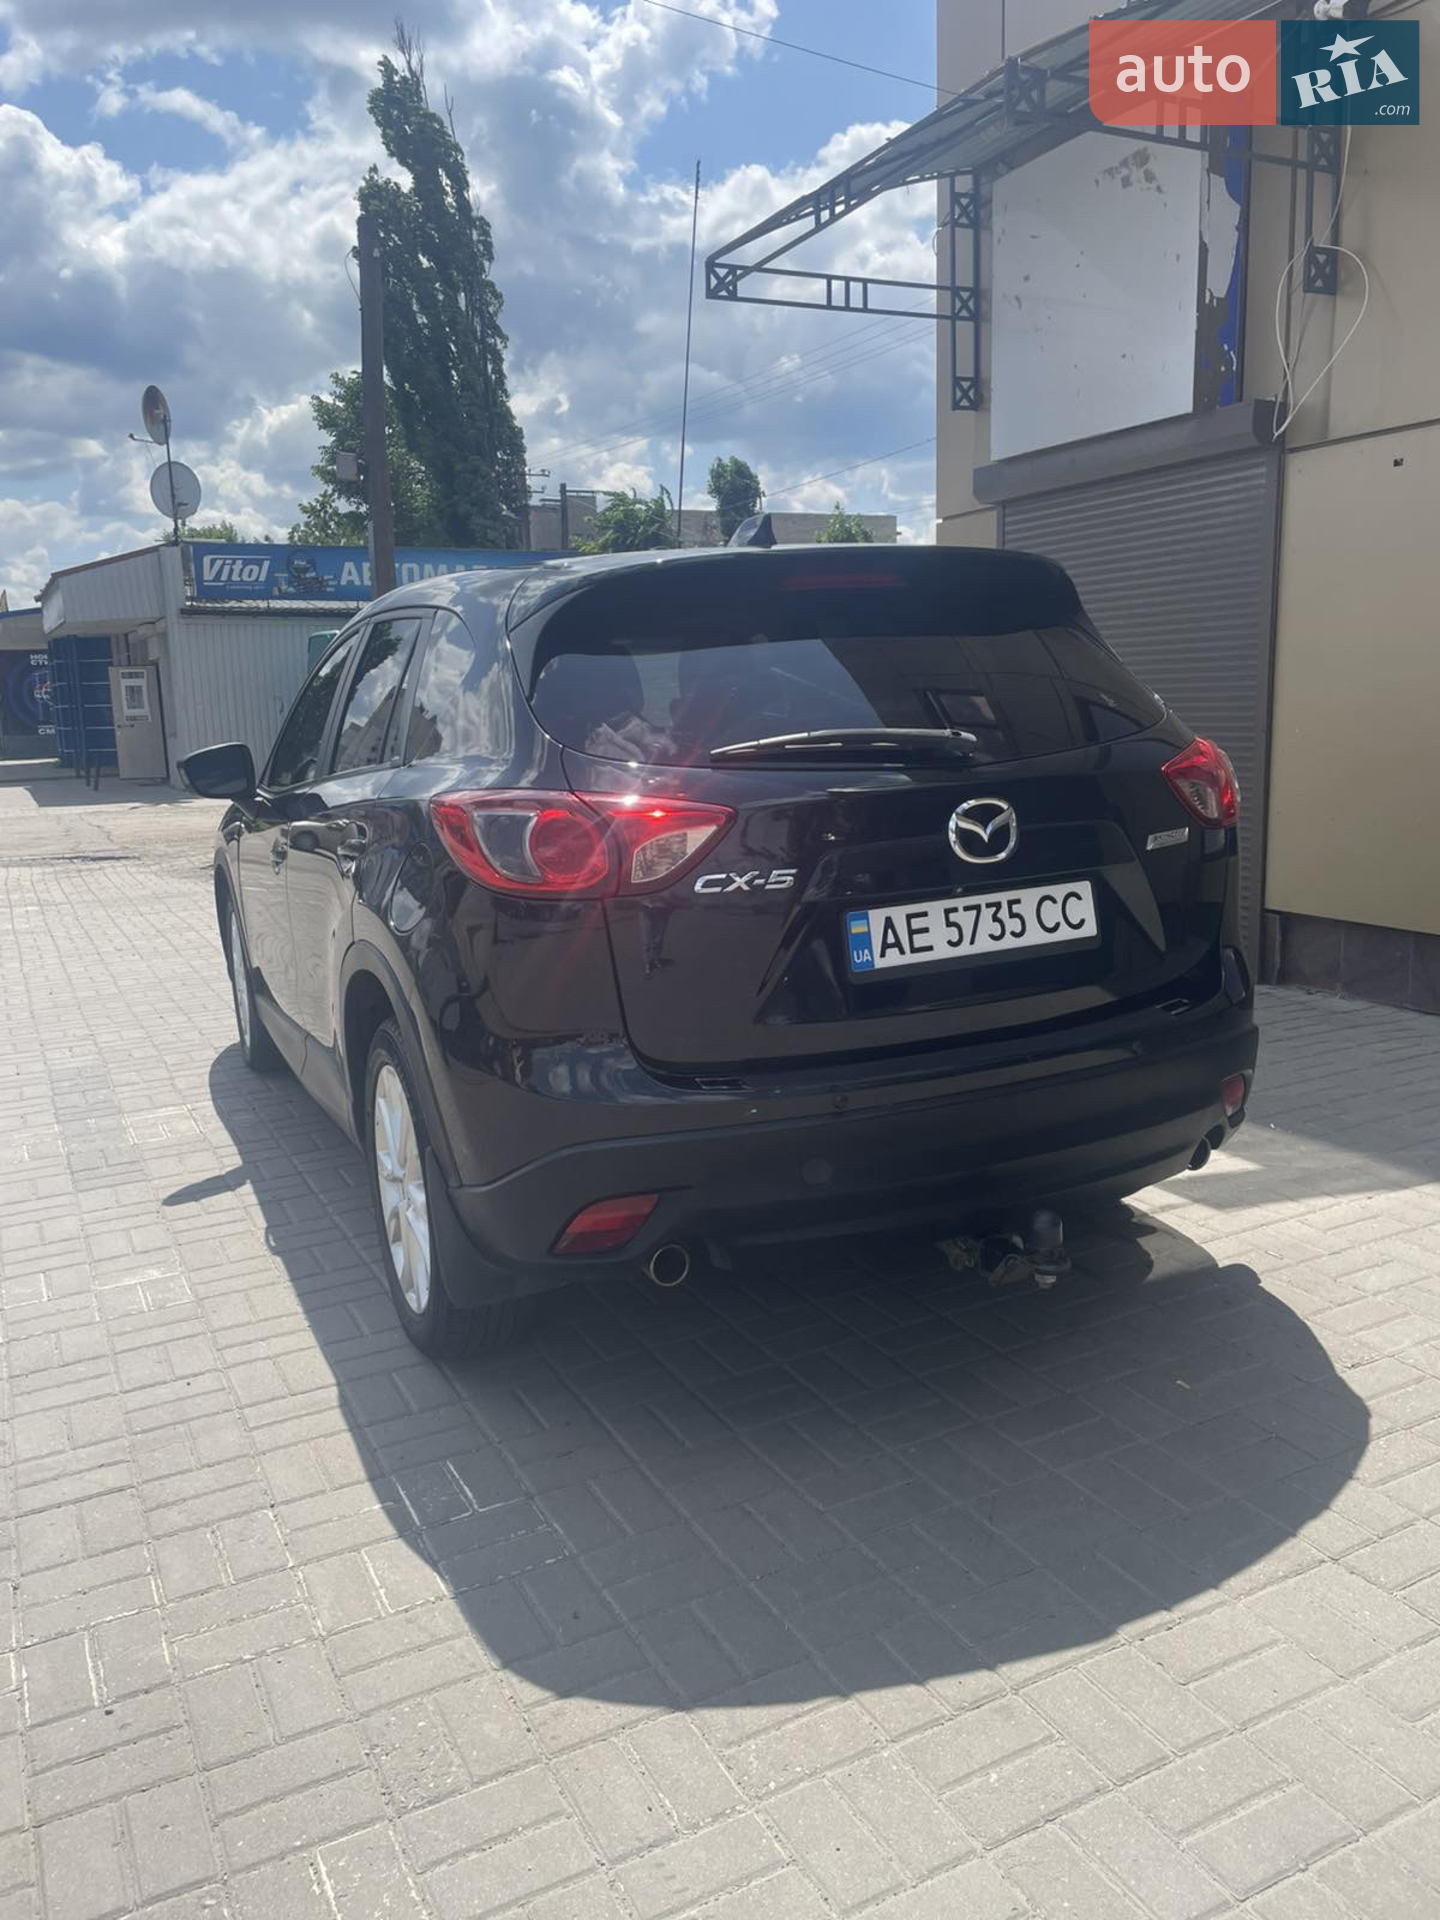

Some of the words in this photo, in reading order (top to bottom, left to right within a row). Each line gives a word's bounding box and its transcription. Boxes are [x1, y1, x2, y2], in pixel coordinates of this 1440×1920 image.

[202, 554, 272, 582] Vitol
[693, 868, 798, 894] CX-5
[879, 911, 935, 959] AE
[943, 898, 1027, 948] 5735
[1035, 890, 1087, 934] CC
[853, 949, 872, 965] UA
